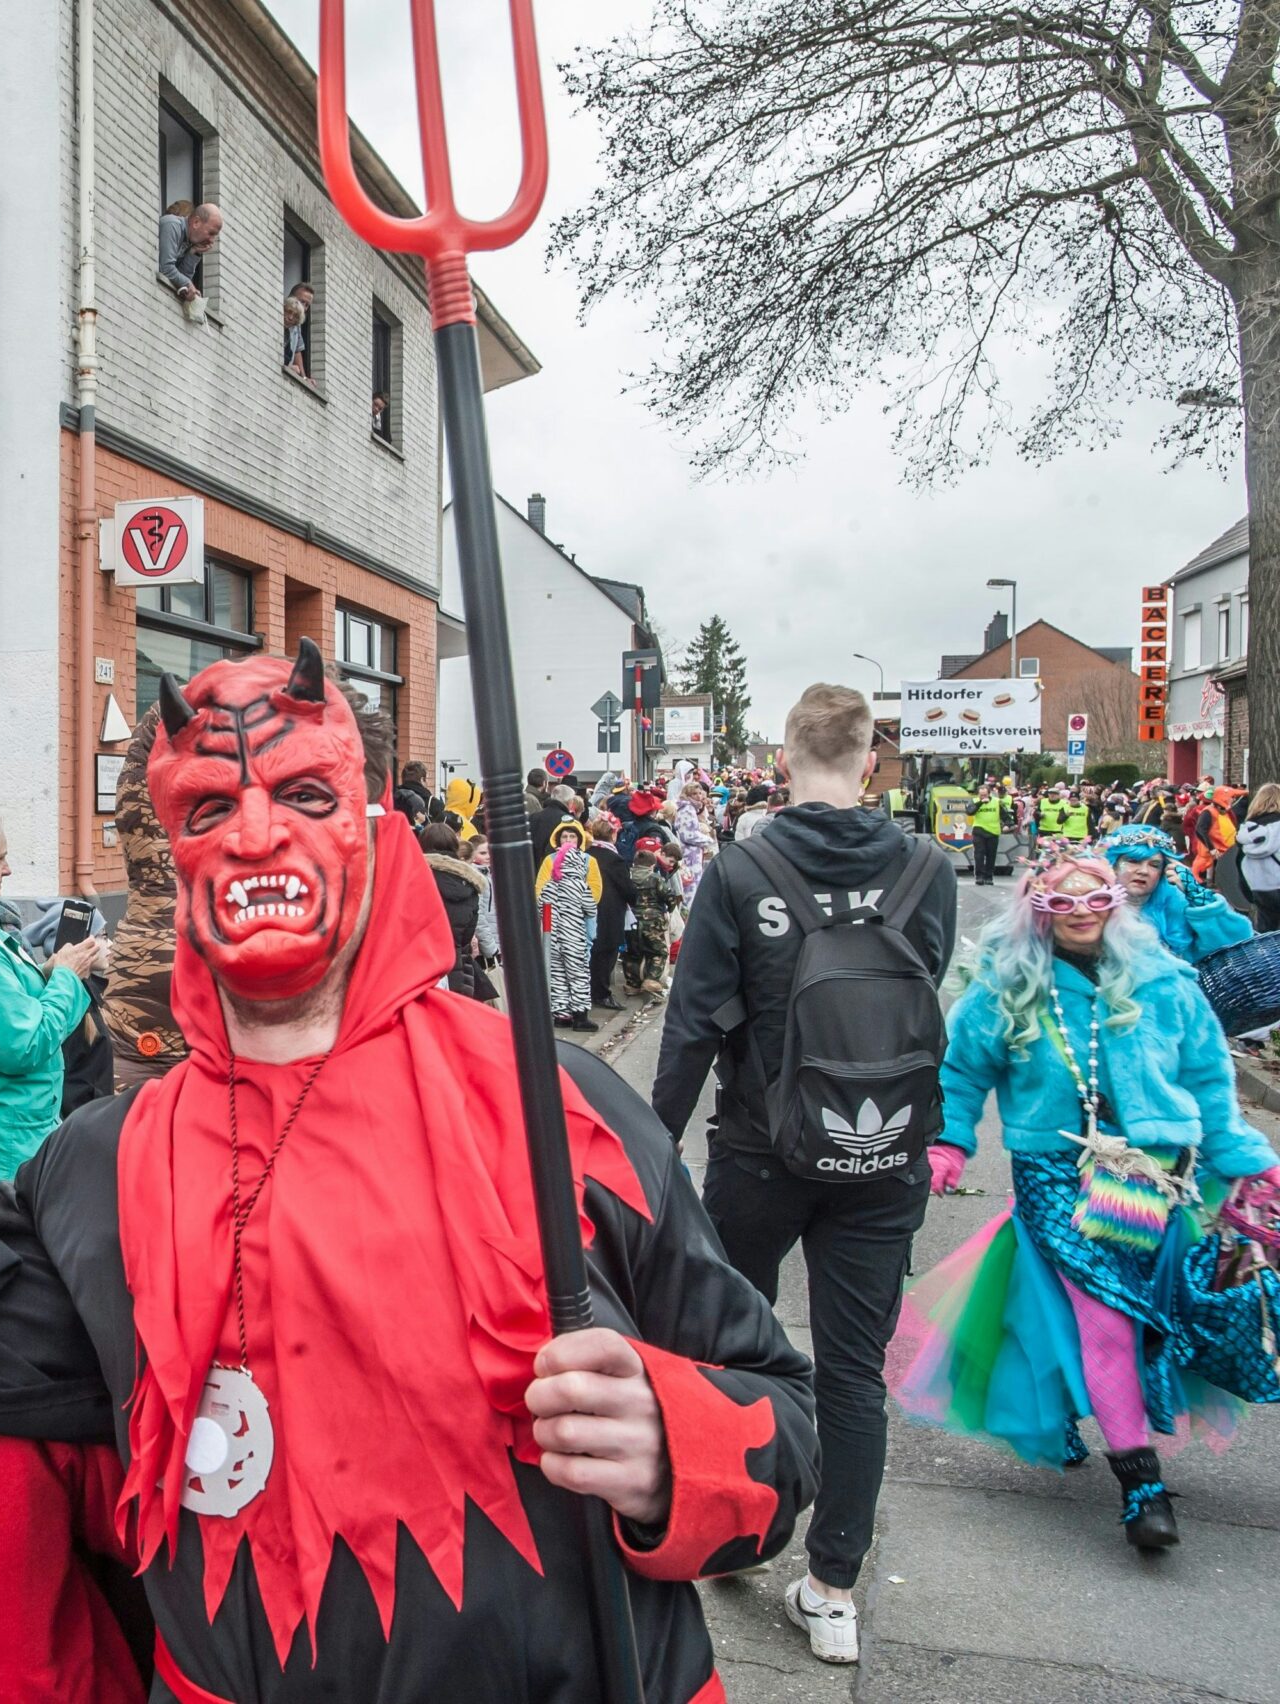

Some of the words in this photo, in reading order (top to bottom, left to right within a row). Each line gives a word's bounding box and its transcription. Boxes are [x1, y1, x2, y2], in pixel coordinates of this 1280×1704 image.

[128, 525, 182, 571] V
[1145, 588, 1165, 739] BÄCKEREI
[100, 664, 112, 678] 241
[908, 688, 983, 701] Hitdorfer
[901, 725, 1041, 739] Geselligkeitsverein
[959, 739, 987, 750] e.V.
[1071, 741, 1082, 755] P
[816, 1151, 908, 1175] adidas
